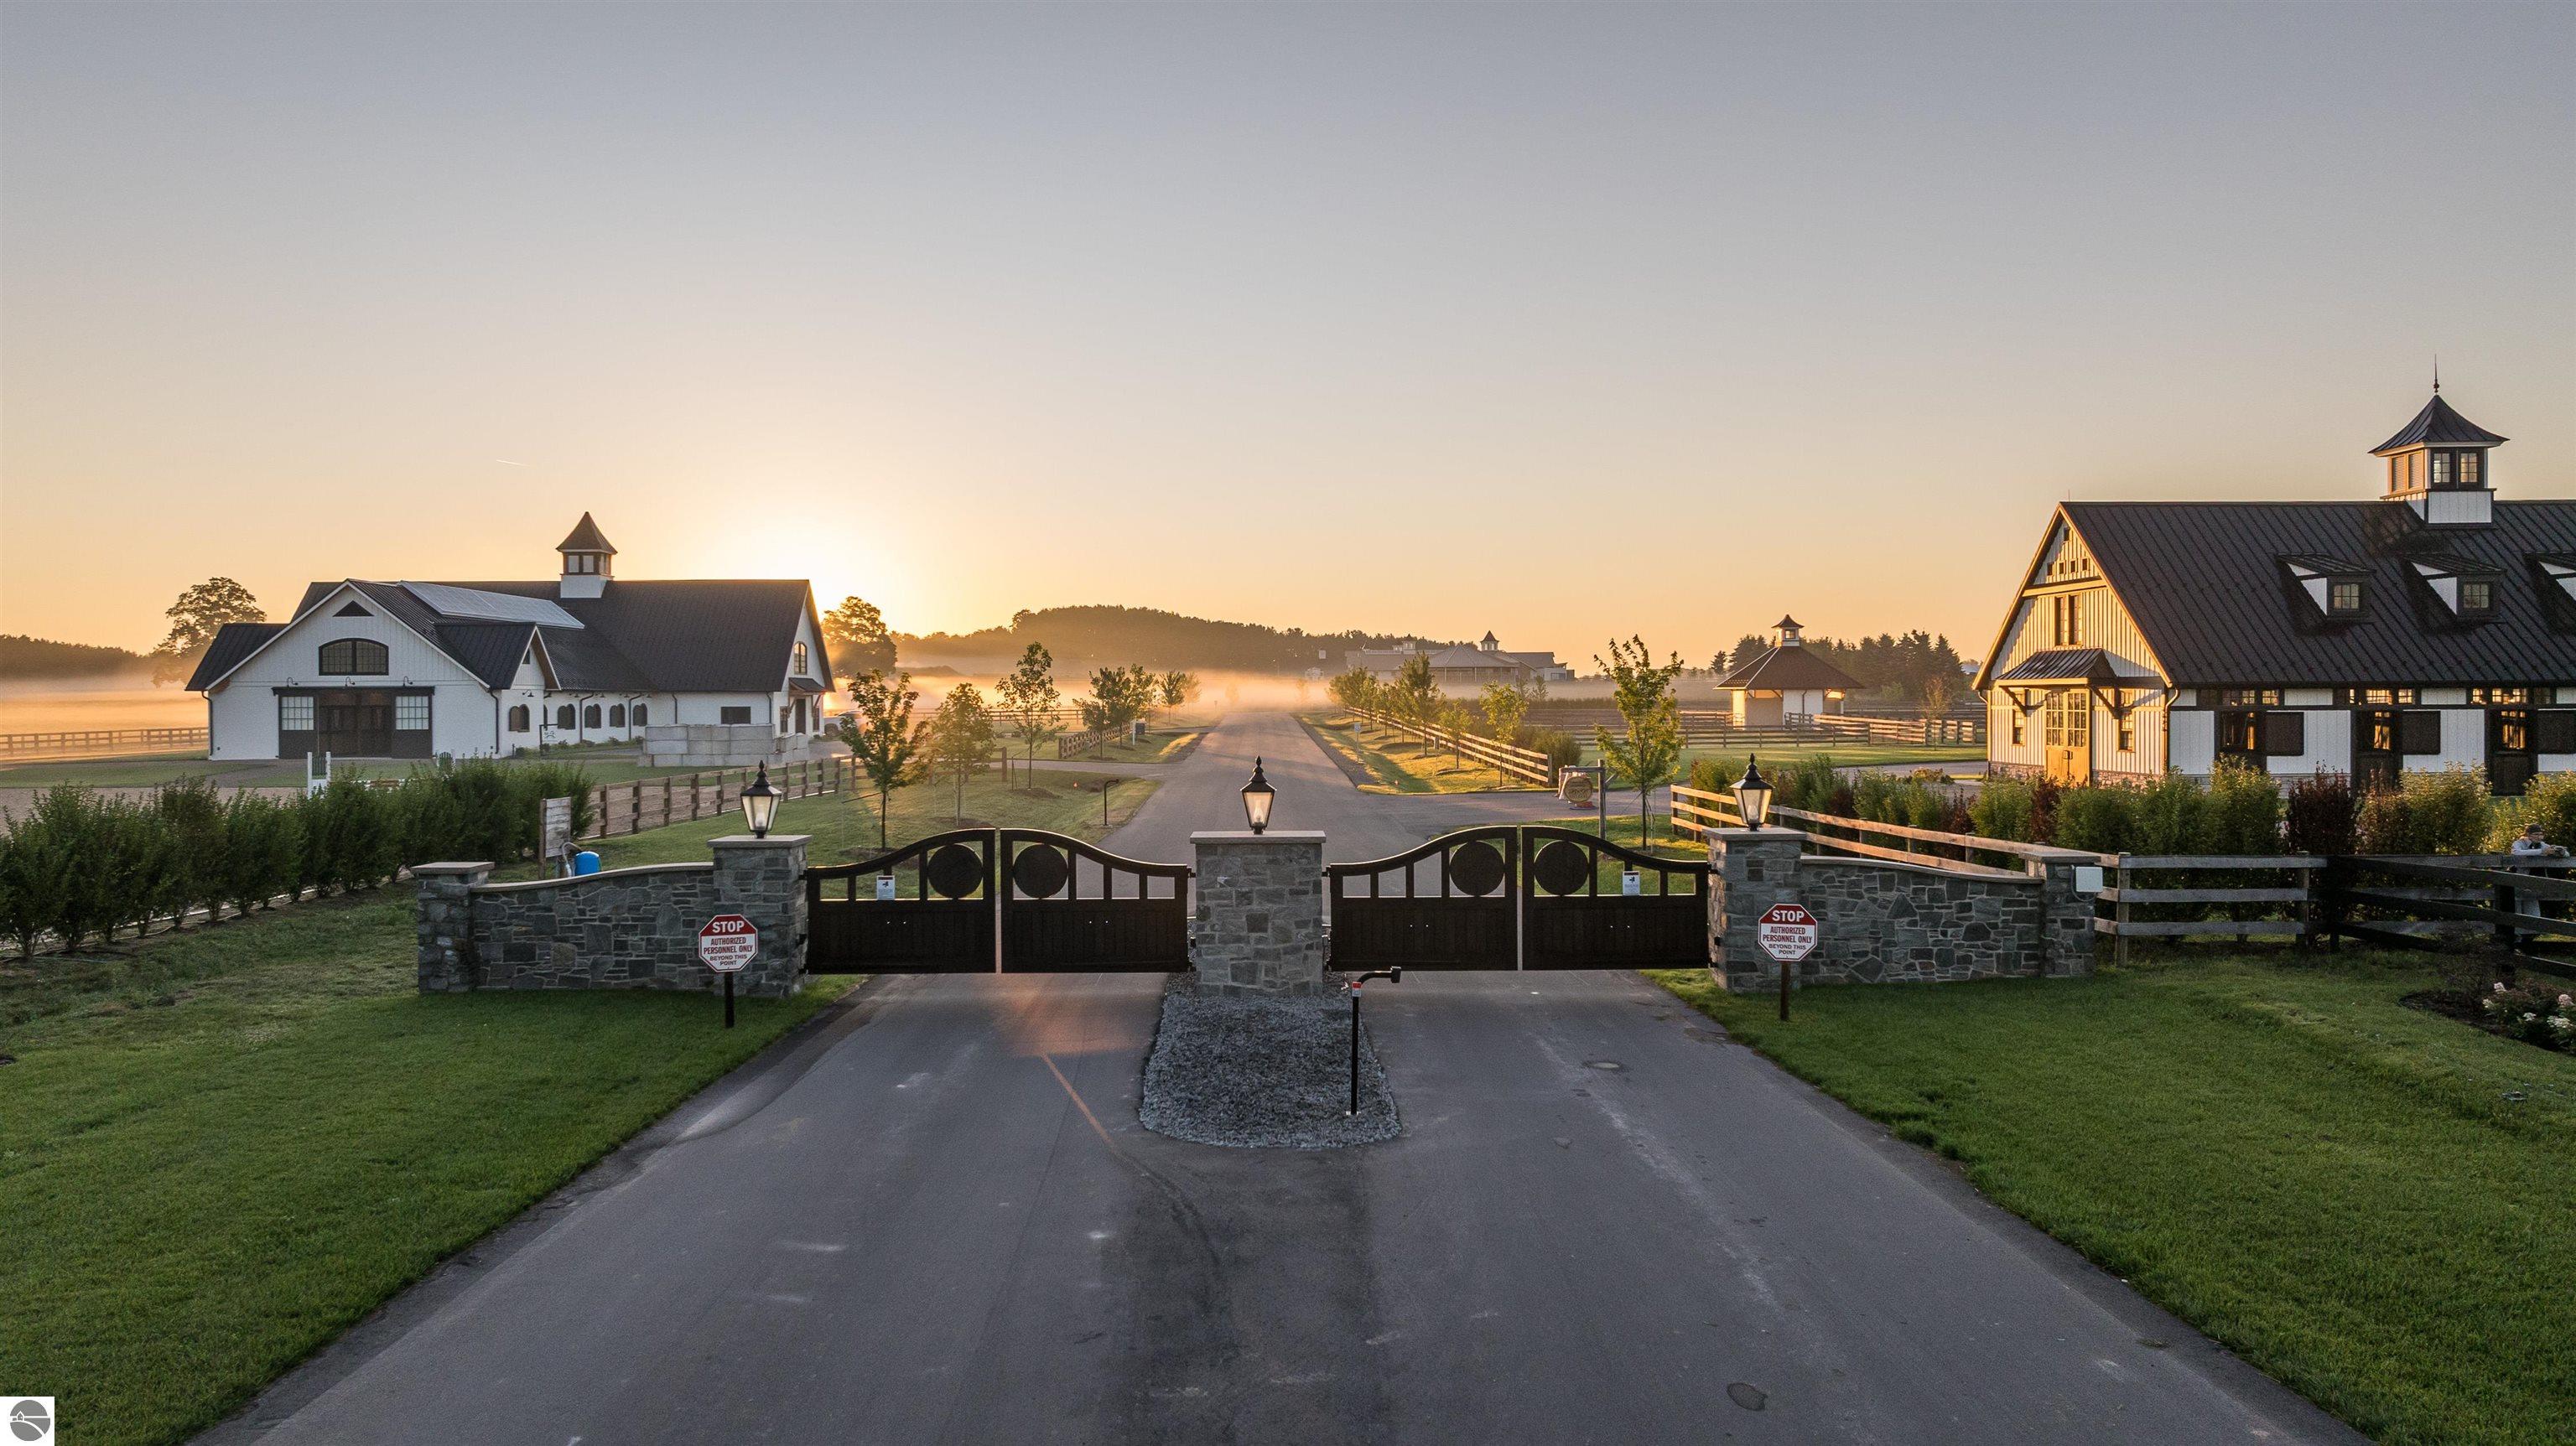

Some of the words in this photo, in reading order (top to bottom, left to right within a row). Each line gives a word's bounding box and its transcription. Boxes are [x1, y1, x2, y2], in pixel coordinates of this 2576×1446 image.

[1772, 910, 1805, 922] STOP
[712, 920, 745, 933] STOP
[1769, 926, 1805, 935] AUTHORIZED
[710, 936, 746, 946] AUTHORIZED
[1763, 934, 1796, 943] PERSONNEL
[704, 946, 737, 954] PERSONNEL
